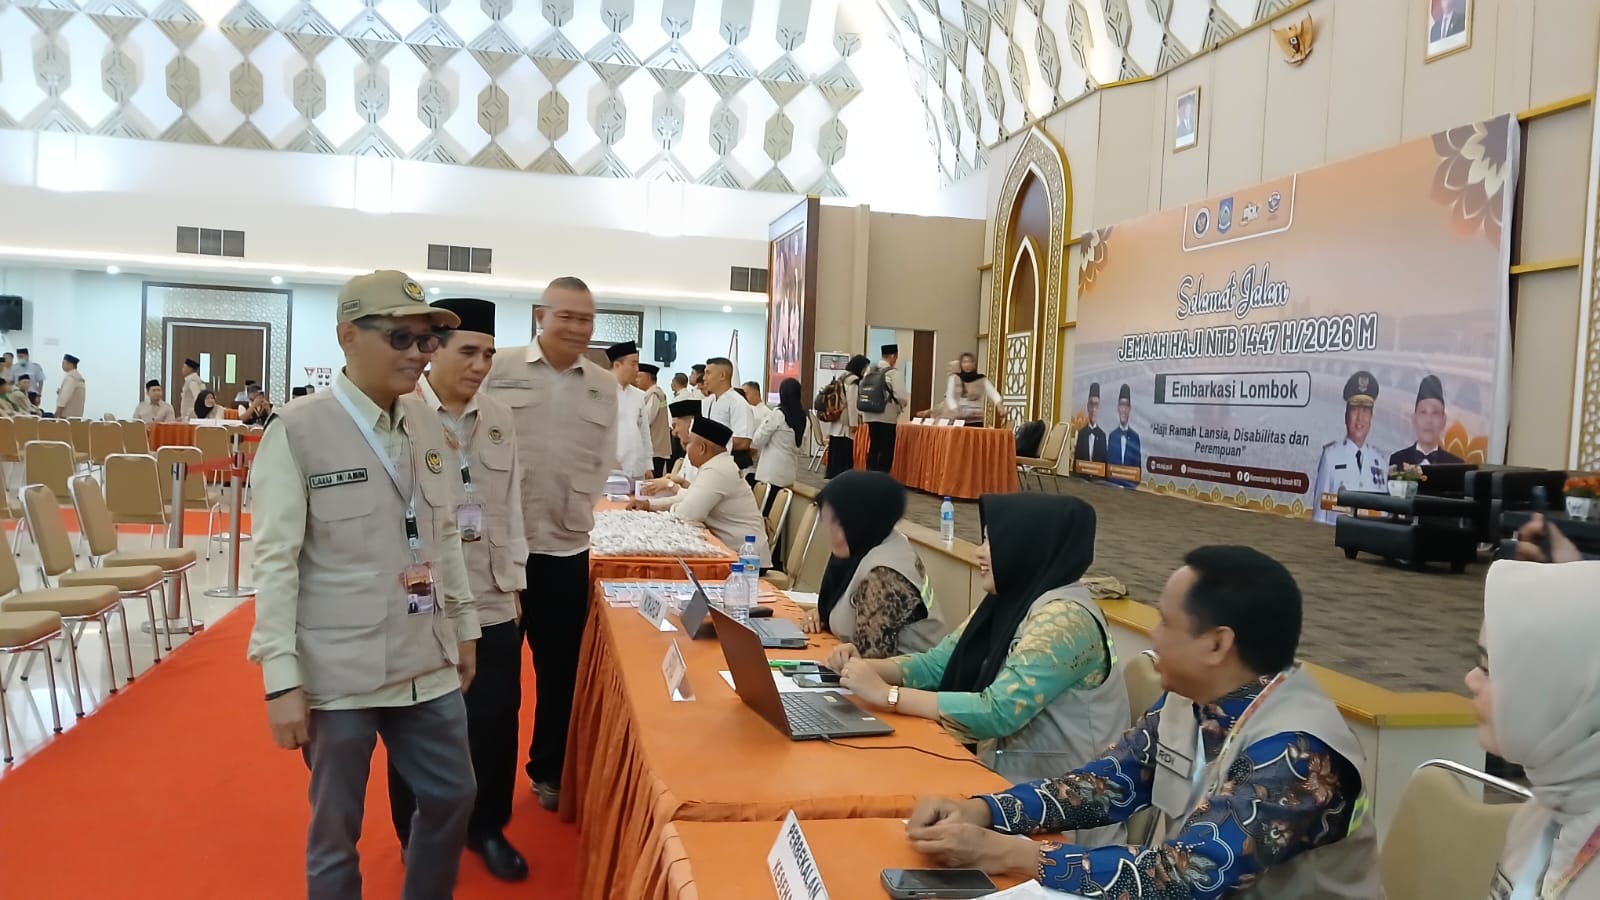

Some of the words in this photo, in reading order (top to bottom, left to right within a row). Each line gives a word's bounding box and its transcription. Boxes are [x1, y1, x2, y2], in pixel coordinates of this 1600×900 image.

[1176, 272, 1237, 320] Selamat
[1235, 263, 1290, 320] Jalan
[1118, 333, 1169, 362] JEMAAH
[1169, 330, 1202, 360] HAJI
[1205, 326, 1238, 358] NTB
[1240, 321, 1280, 355] 1447
[1281, 315, 1355, 354] H/2026
[1357, 312, 1378, 350] M
[1171, 380, 1236, 398] Embarkasi
[1240, 378, 1298, 399] Lombok
[1169, 424, 1197, 437] Ramah
[1199, 426, 1231, 442] Lansia,
[1233, 428, 1286, 445] Disabilitas
[1289, 430, 1309, 447] dan
[787, 822, 822, 900] PERBEKALAN
